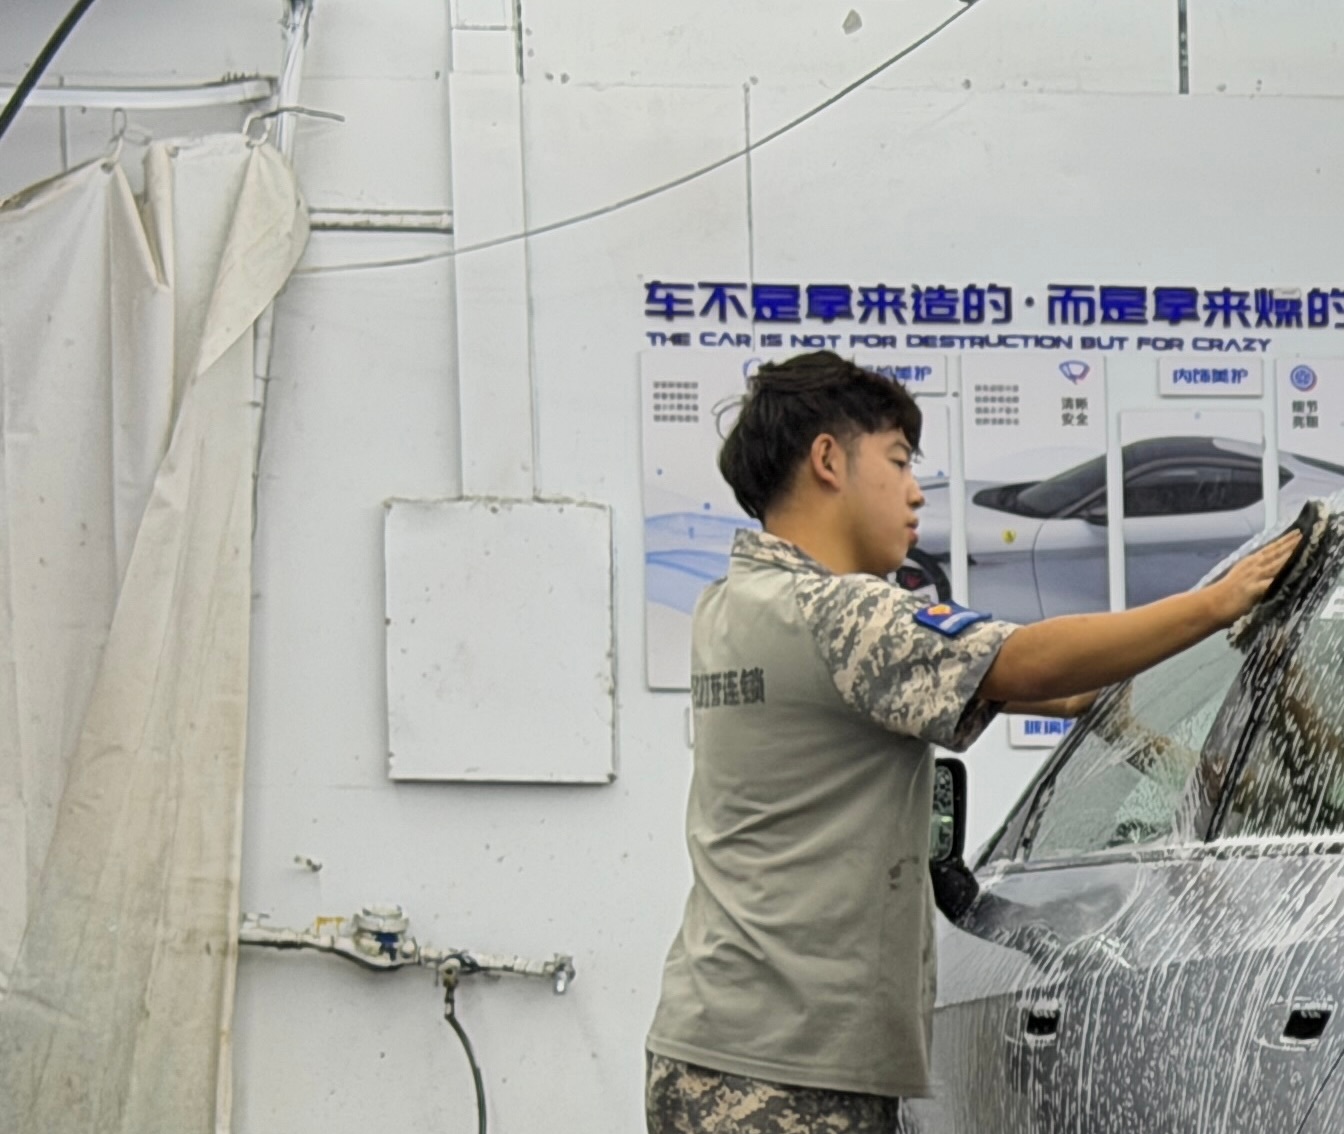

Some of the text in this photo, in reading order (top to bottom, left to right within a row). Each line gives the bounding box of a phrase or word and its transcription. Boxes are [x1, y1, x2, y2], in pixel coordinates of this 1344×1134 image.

[646, 331, 1272, 353] THE CAR IS NOT FOR DESTRUCTION BUT FOR CRAZY
[1172, 367, 1249, 385] 内饰美护
